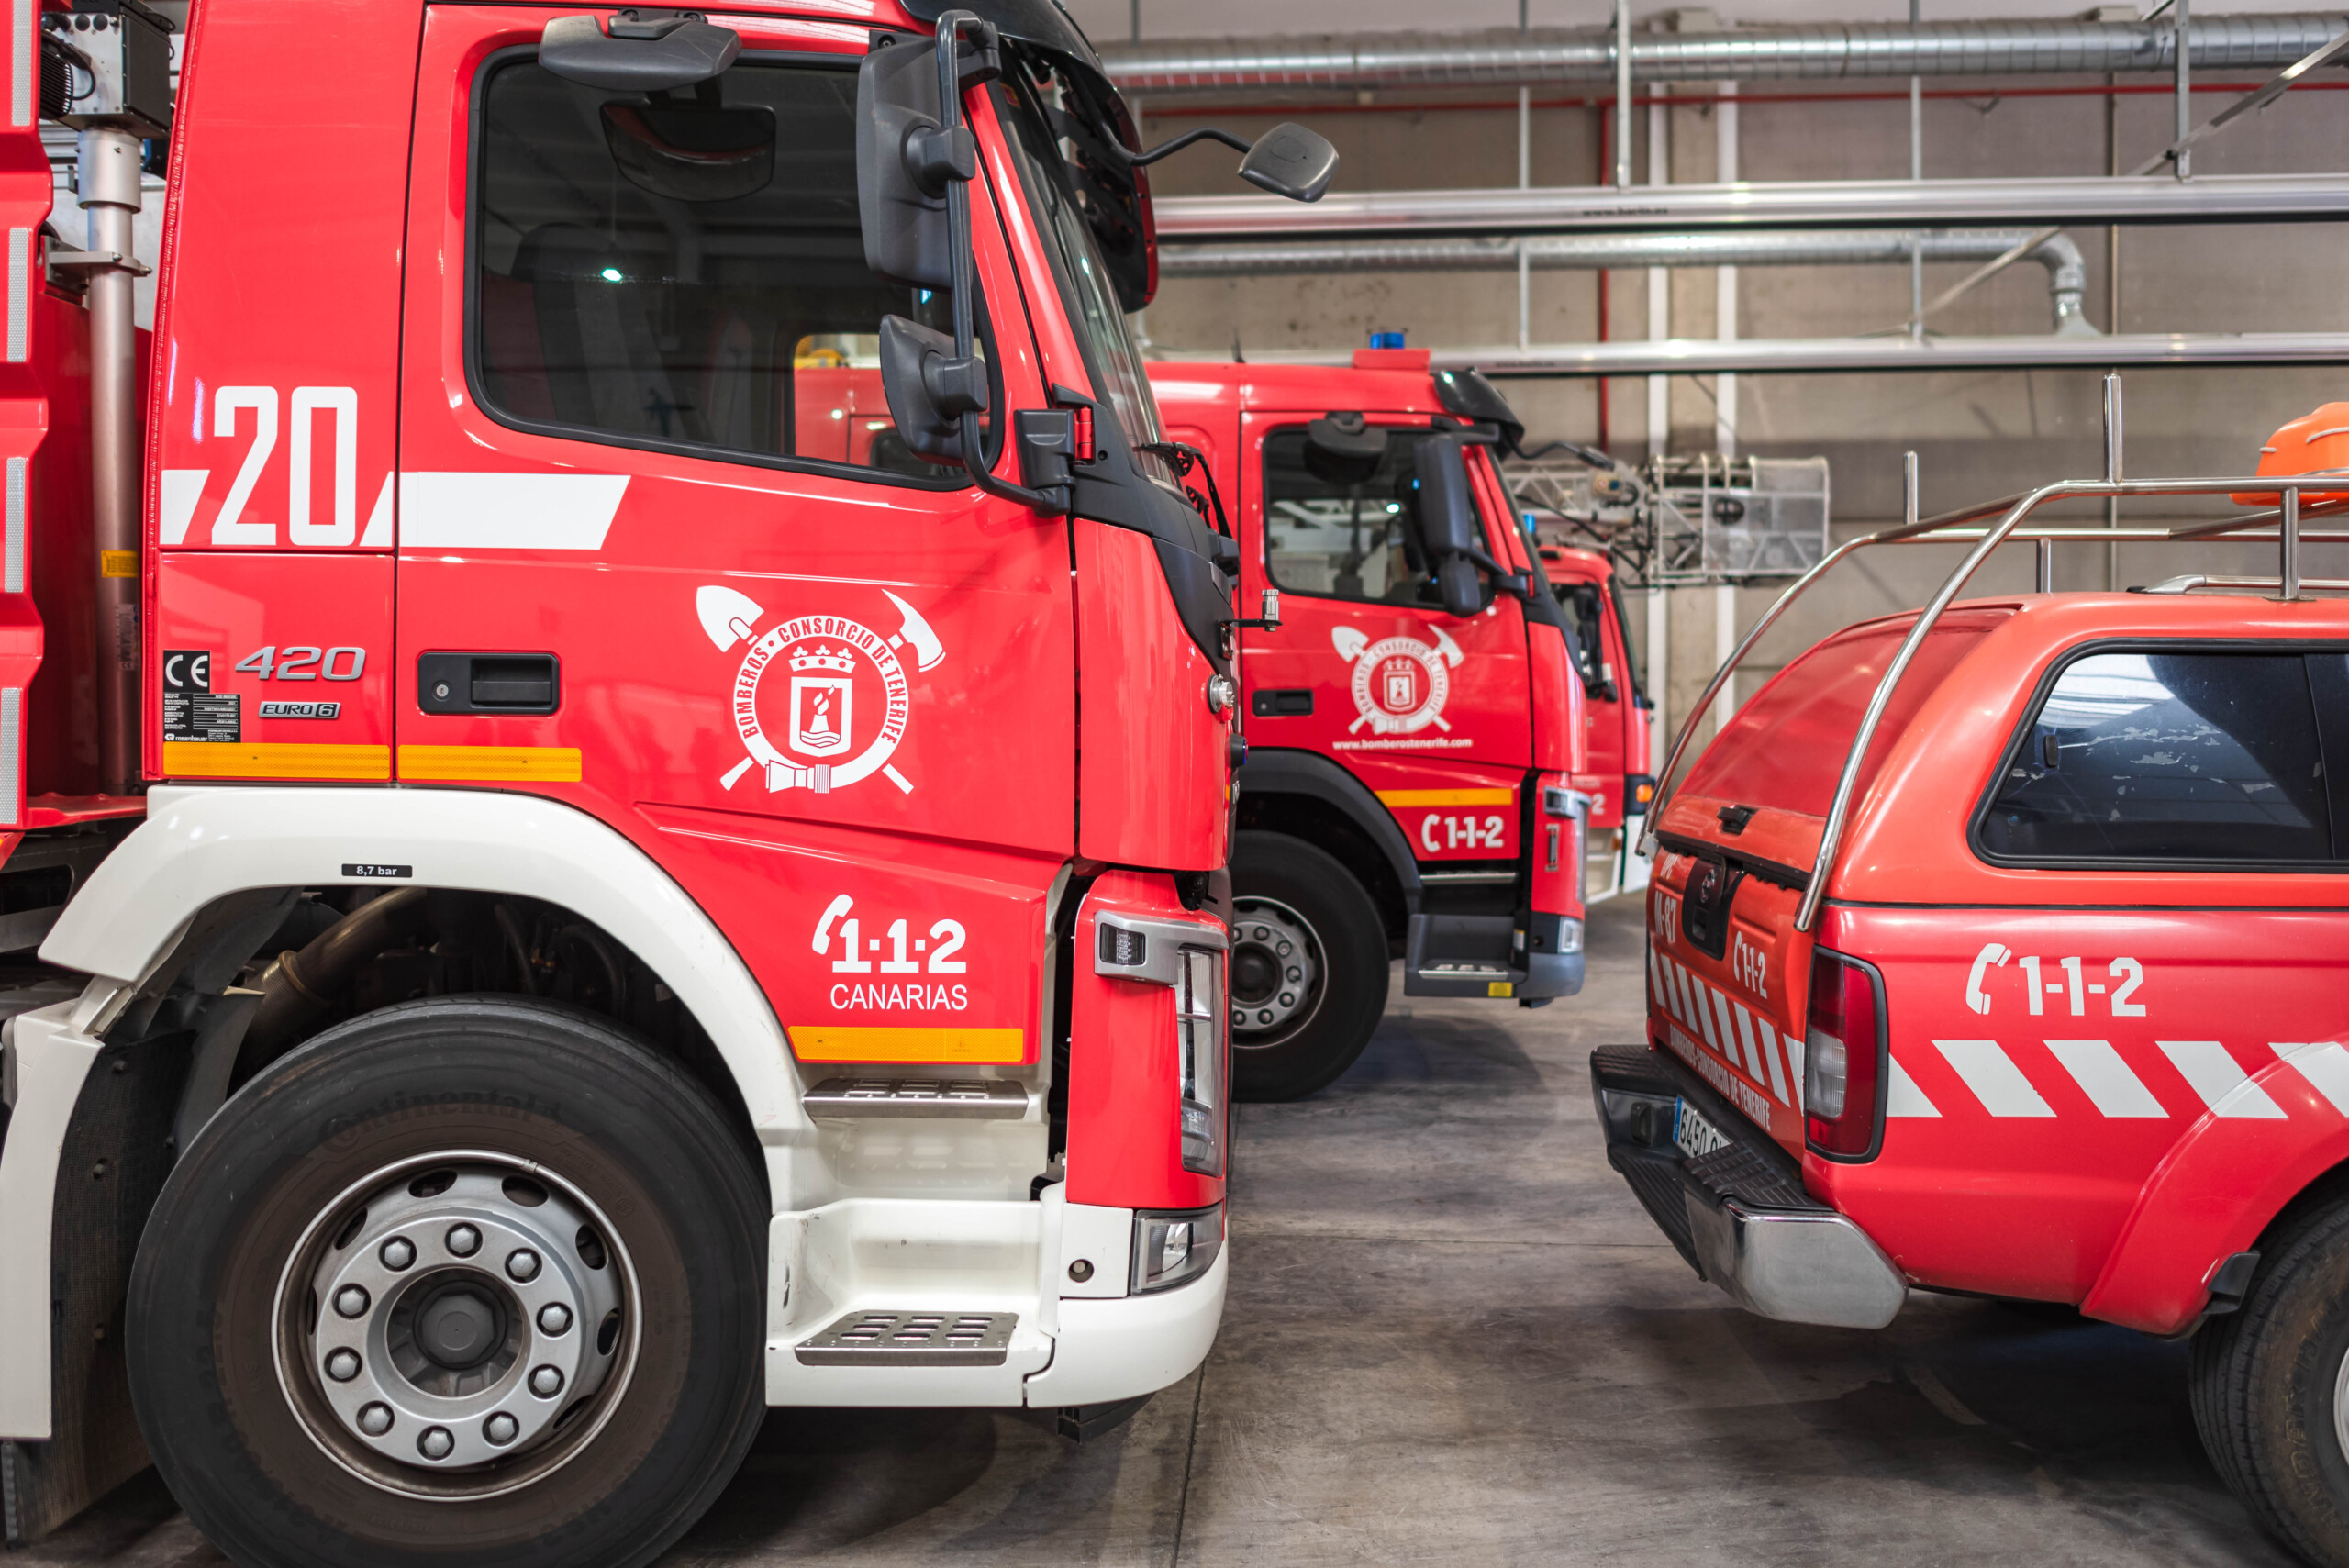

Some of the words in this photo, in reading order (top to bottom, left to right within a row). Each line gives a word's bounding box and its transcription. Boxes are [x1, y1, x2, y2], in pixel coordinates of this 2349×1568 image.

[211, 385, 358, 546] 20
[777, 617, 874, 649] CONSORCIO
[235, 646, 366, 680] 420
[871, 644, 894, 669] DE
[736, 646, 769, 740] BOMBEROS
[881, 668, 907, 744] TENERIFE
[1332, 737, 1473, 751] www.bomberostenerife.com
[1444, 815, 1504, 849] 1-1-2
[356, 865, 374, 876] 8,7
[377, 866, 397, 875] bar
[1654, 890, 1677, 945] M-87
[1742, 943, 1767, 1000] 1-1-2
[2019, 956, 2147, 1017] 1-1-2
[830, 984, 968, 1010] CANARIAS
[1739, 1079, 1771, 1132] TENERIFE
